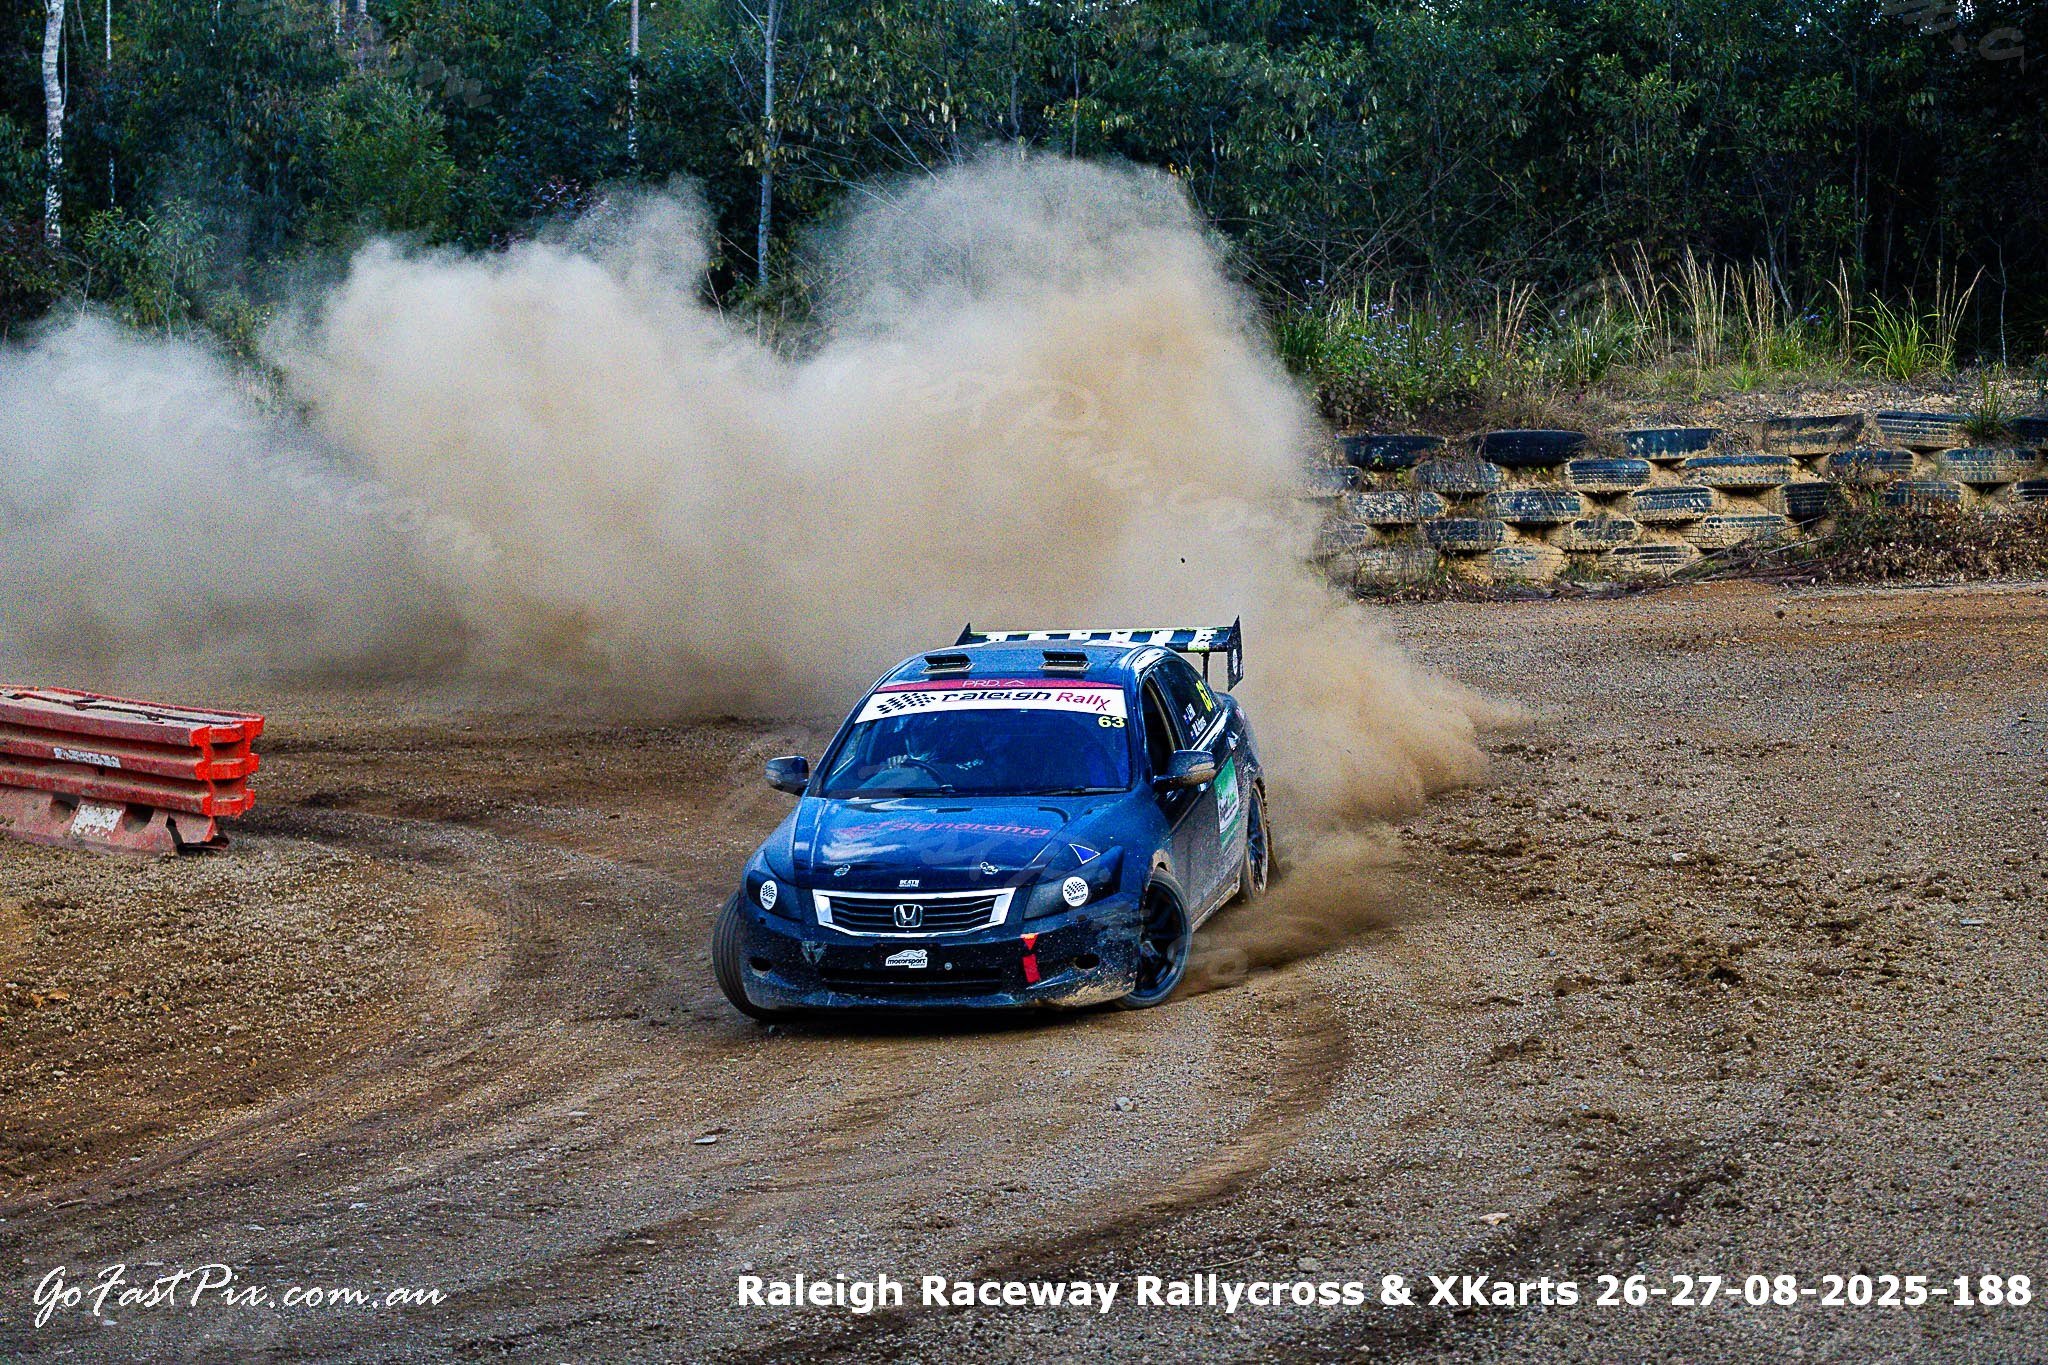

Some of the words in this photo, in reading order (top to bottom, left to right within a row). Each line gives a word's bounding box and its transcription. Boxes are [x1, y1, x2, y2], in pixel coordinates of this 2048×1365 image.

[941, 690, 1052, 702] raleigh
[1098, 715, 1125, 728] 63
[890, 821, 1050, 837] signarama
